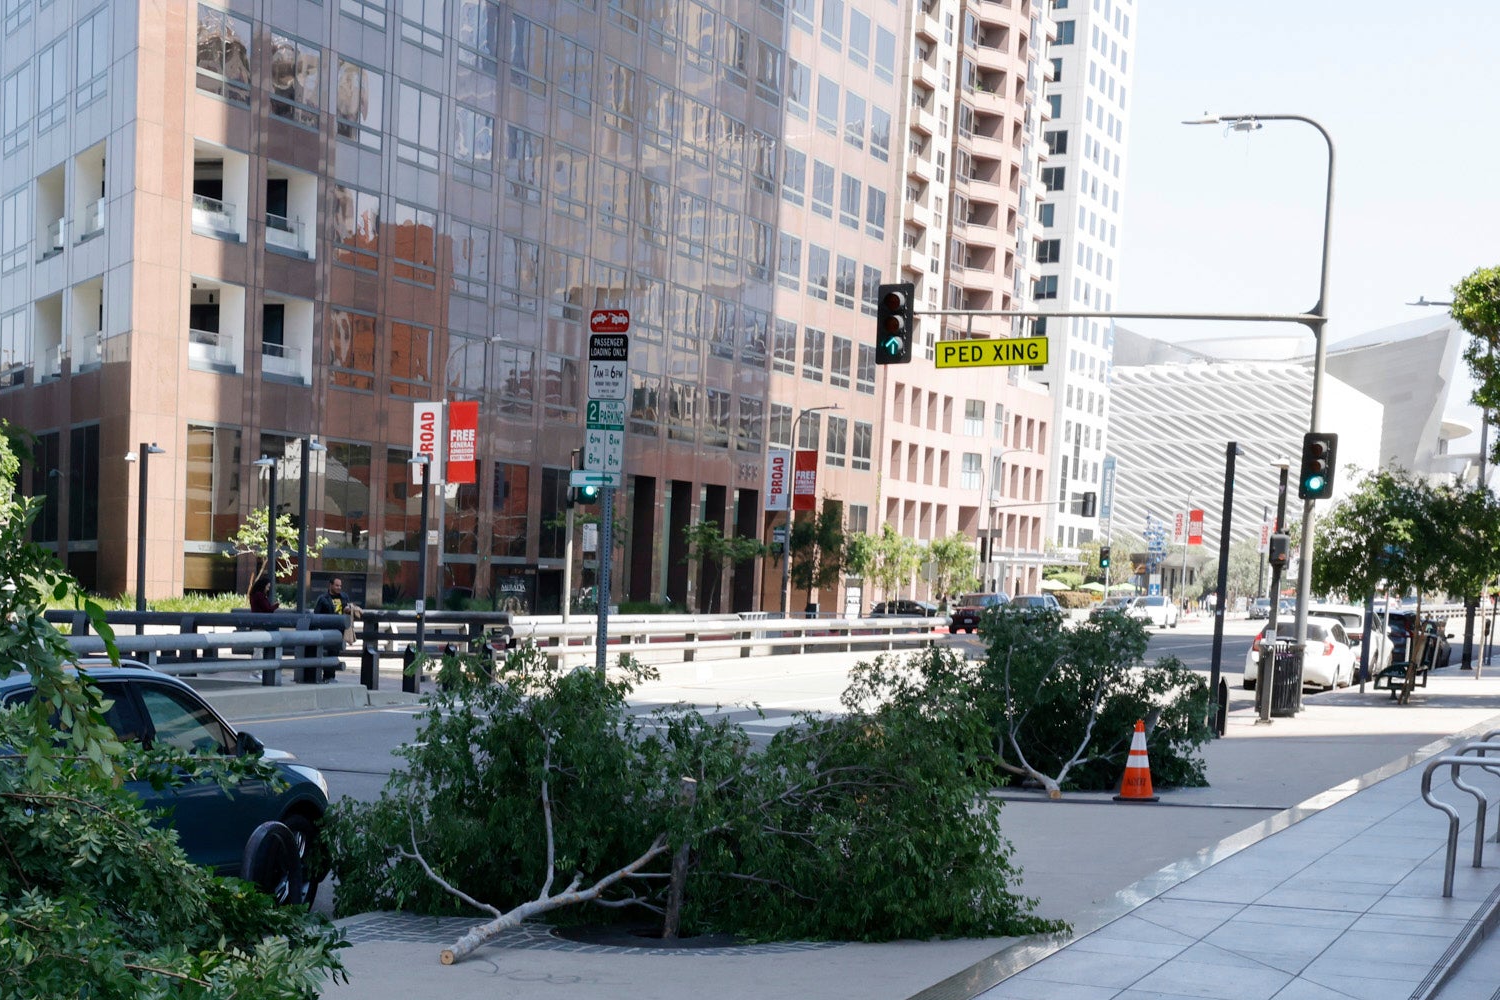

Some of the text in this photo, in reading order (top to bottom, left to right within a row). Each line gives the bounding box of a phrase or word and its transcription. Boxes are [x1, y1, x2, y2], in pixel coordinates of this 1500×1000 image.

[594, 337, 624, 347] PASSENGER
[590, 348, 627, 357] LOADING ONLY
[944, 343, 1039, 363] PED XING
[592, 365, 604, 379] 7AM
[610, 365, 623, 379] 6PM
[589, 403, 597, 421] 2
[600, 410, 624, 424] PARKING
[449, 429, 475, 442] FREE
[589, 433, 601, 444] 6PM
[588, 453, 600, 465] 8PM
[608, 454, 619, 466] 8PM
[771, 457, 785, 494] BROAD
[795, 470, 816, 480] FREE
